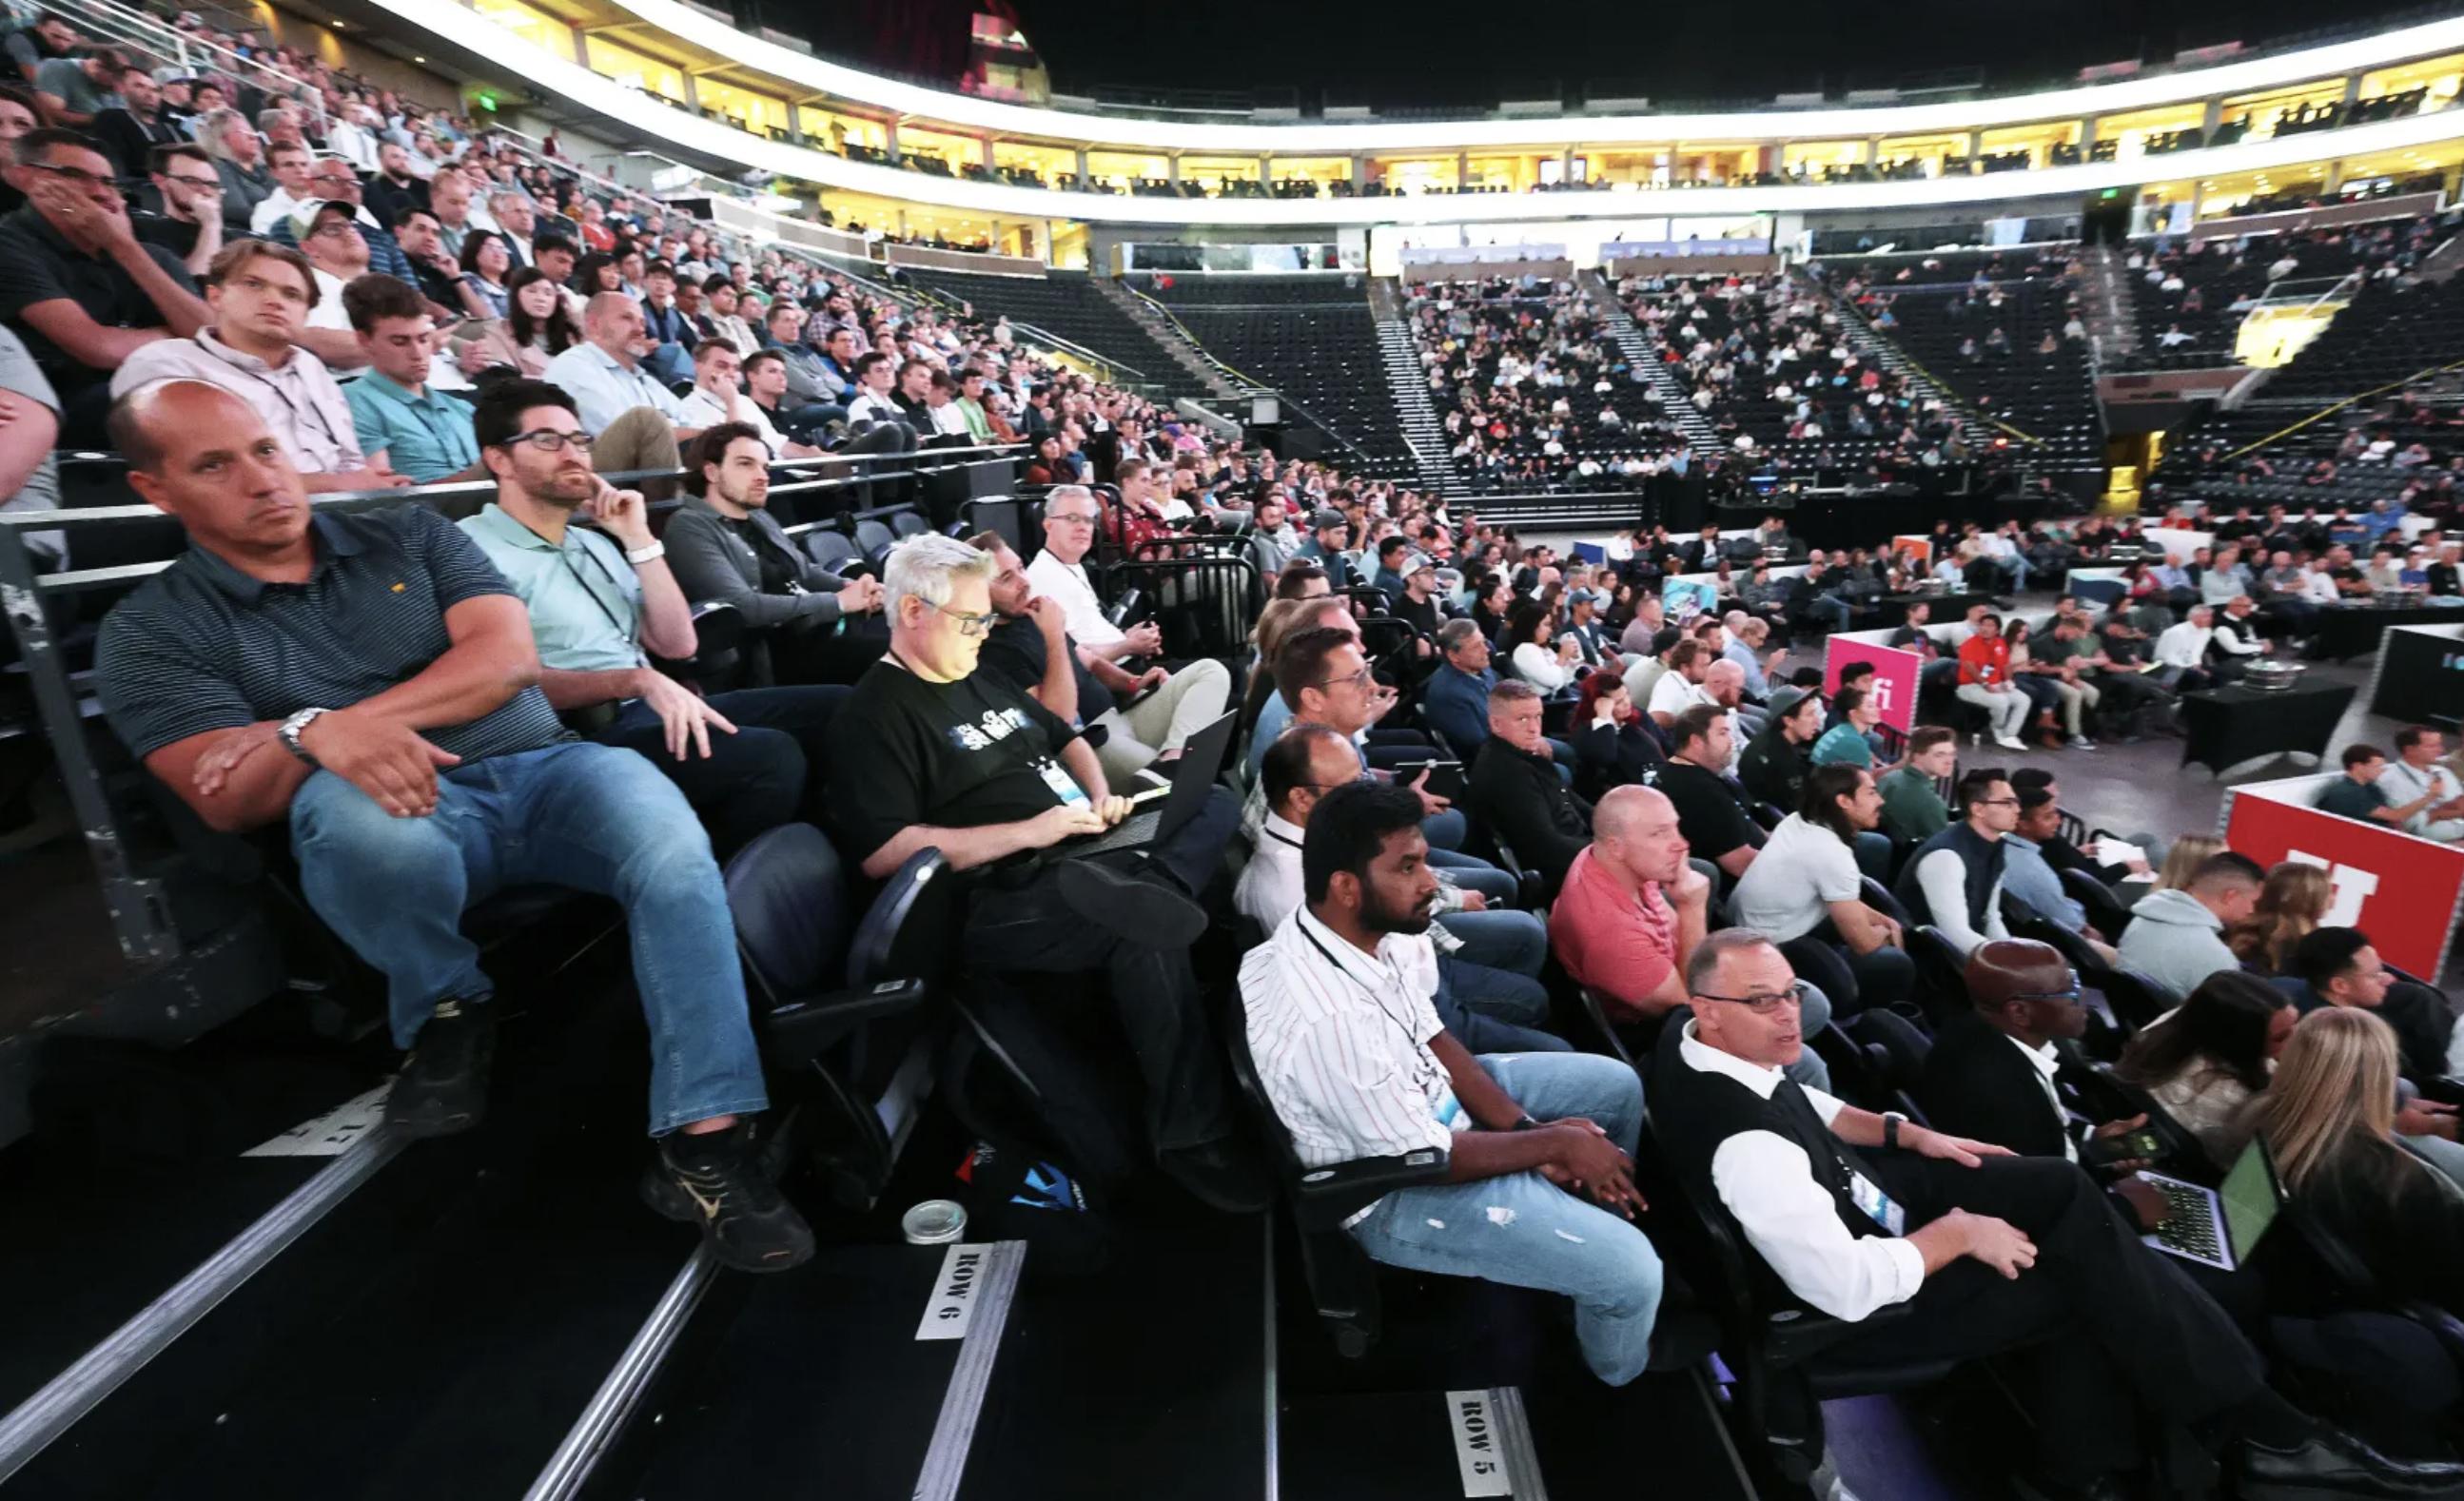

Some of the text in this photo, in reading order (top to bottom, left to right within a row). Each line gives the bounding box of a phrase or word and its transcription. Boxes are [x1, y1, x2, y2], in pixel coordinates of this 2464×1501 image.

[939, 1253, 980, 1319] ROW 6
[1461, 1401, 1496, 1475] ROW 5
